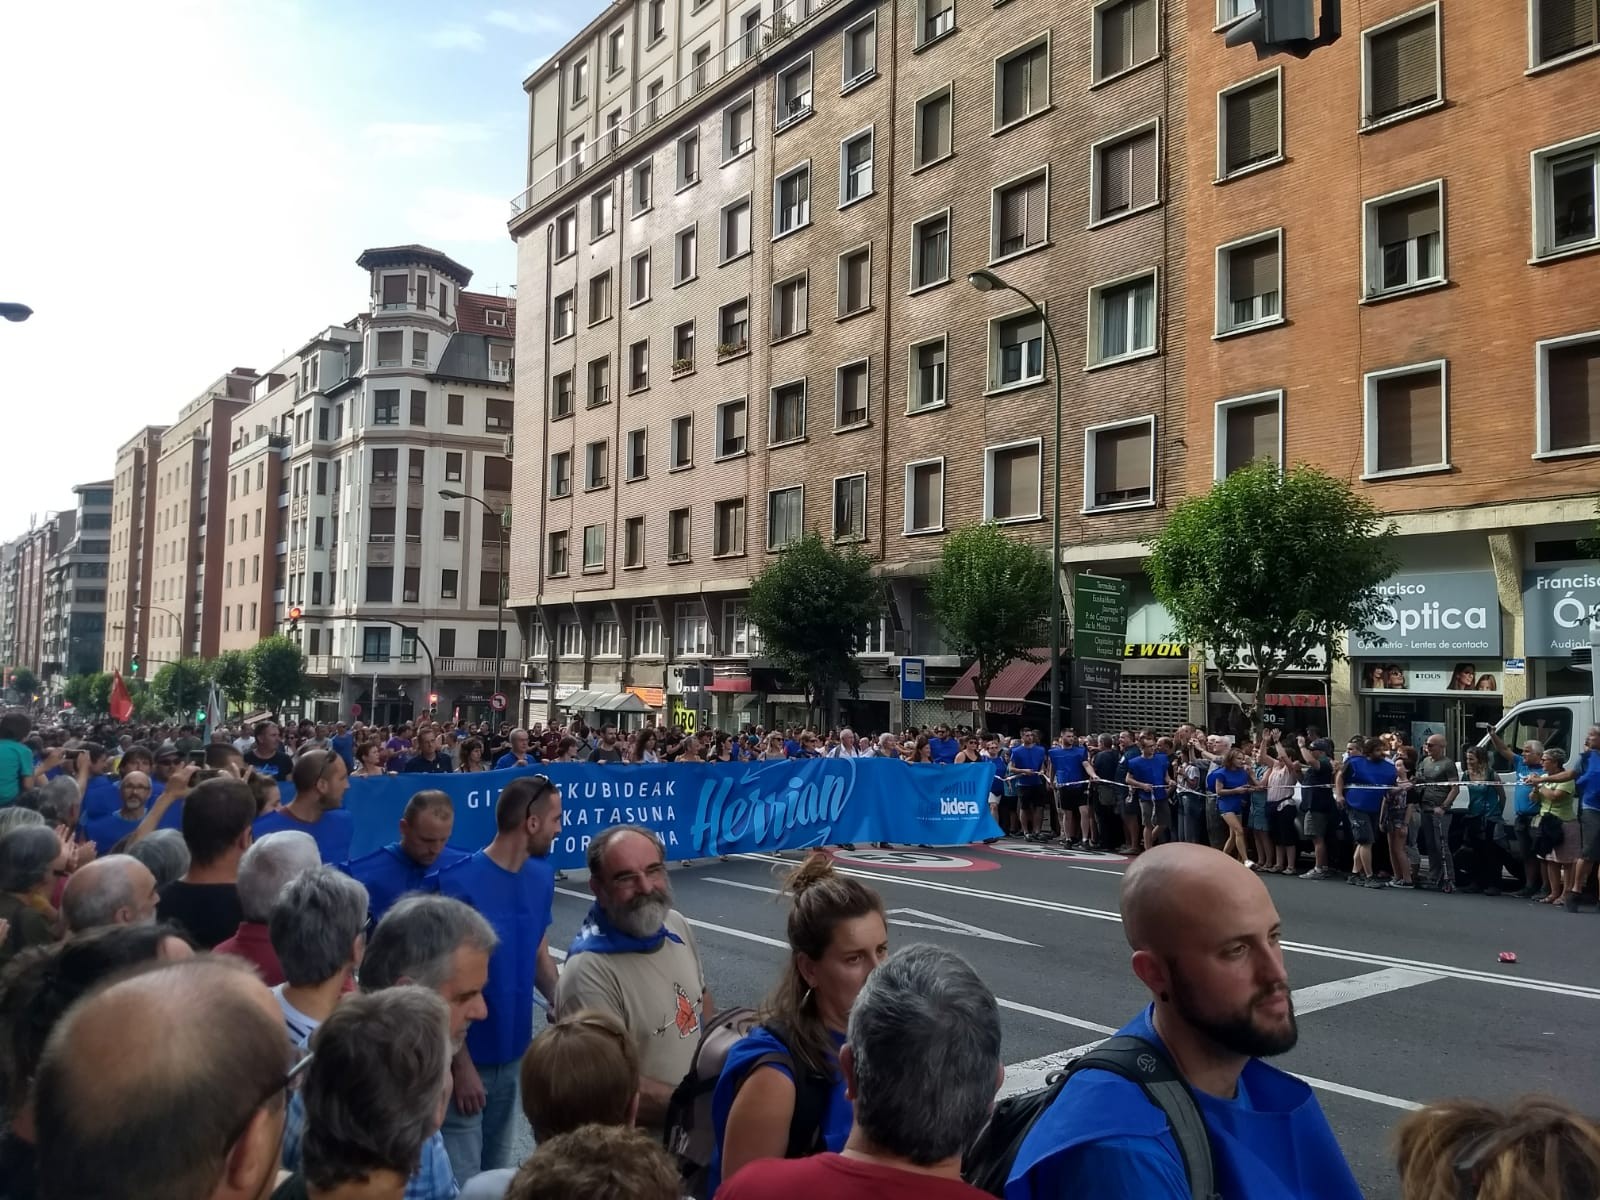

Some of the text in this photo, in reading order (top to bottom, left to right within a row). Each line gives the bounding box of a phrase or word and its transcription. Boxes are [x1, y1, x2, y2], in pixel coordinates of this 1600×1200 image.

[1141, 644, 1182, 657] WOK
[1411, 641, 1436, 649] Lentes
[1439, 640, 1450, 649] de
[1452, 640, 1489, 649] contacto
[972, 702, 992, 711] BR
[690, 766, 852, 857] Herrian
[940, 797, 979, 815] bidera
[847, 852, 956, 864] 50
